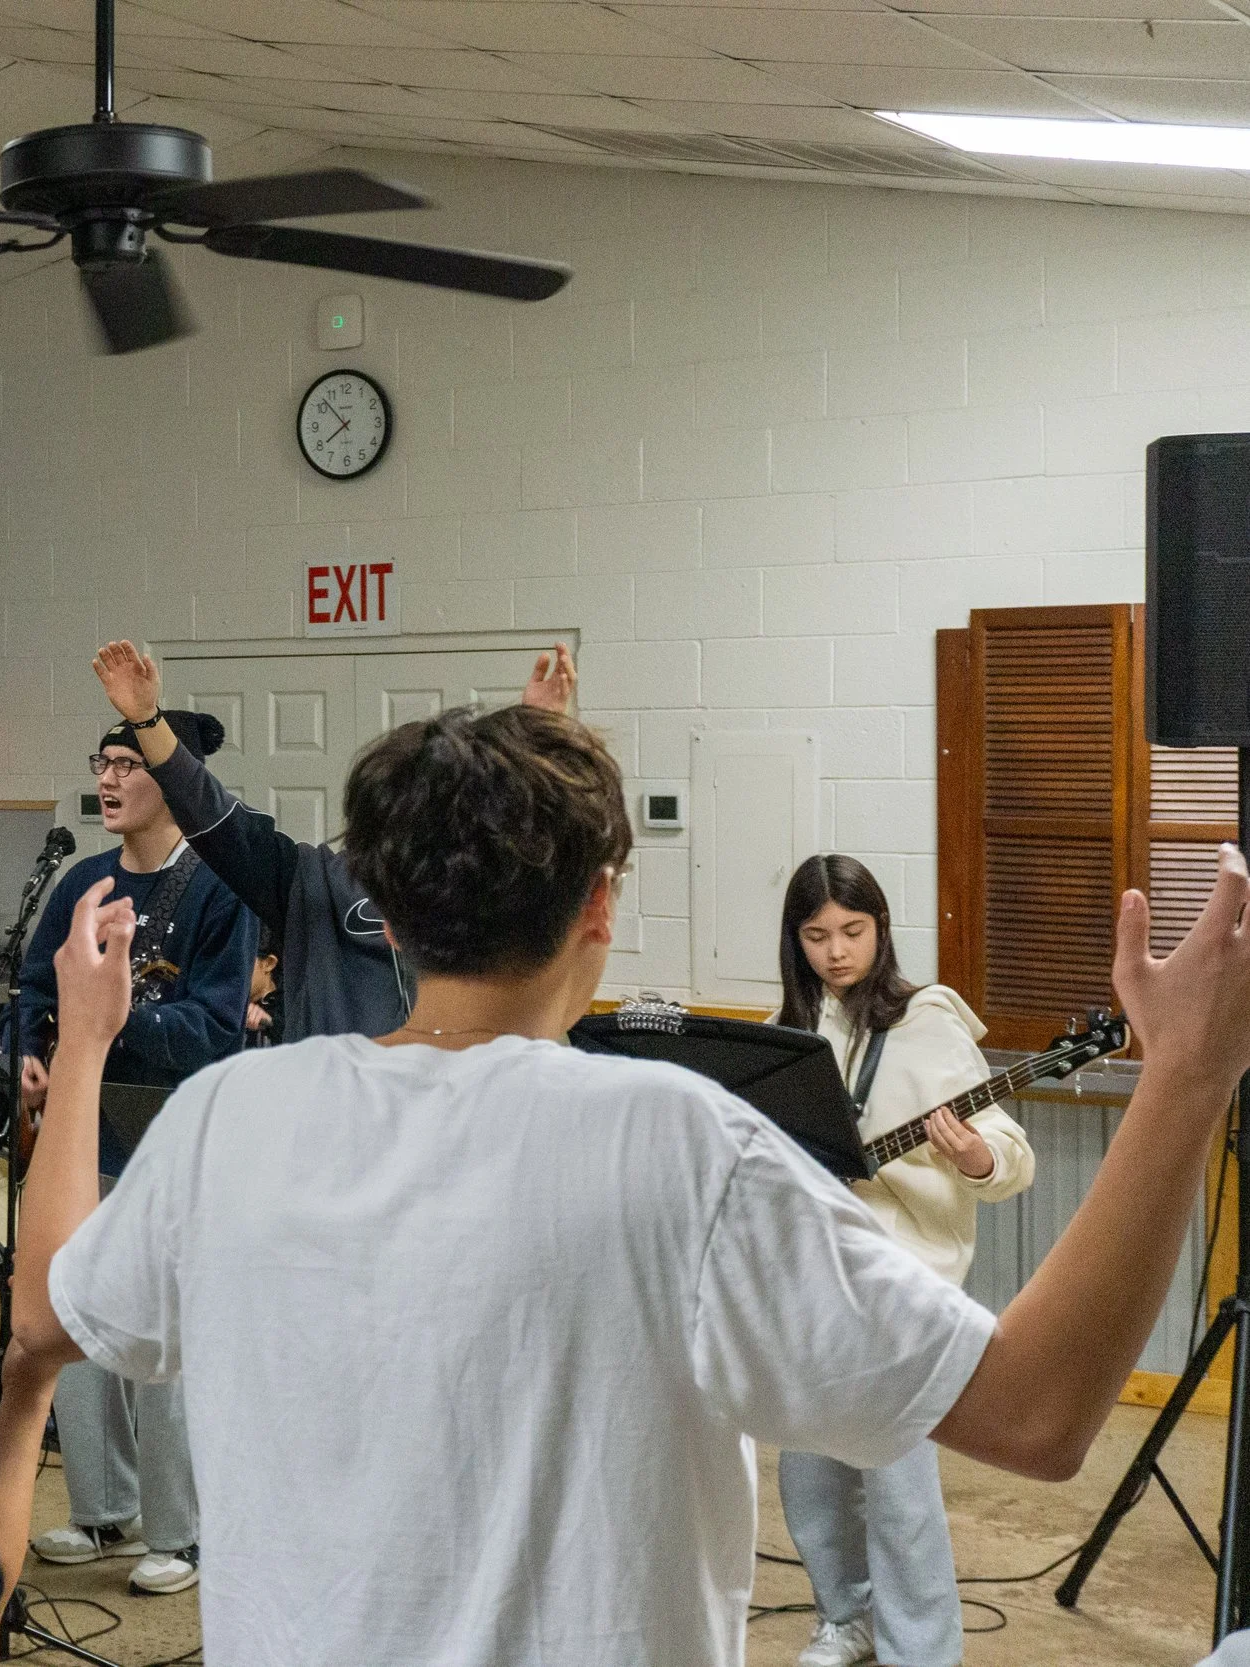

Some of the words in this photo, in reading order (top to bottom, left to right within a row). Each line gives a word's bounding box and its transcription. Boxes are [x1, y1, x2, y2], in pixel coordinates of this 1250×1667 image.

[340, 383, 352, 394] 12
[359, 387, 364, 398] 1
[328, 391, 336, 400] 11
[317, 402, 327, 414] 10
[370, 399, 377, 410] 2
[312, 422, 319, 433] 9
[375, 417, 382, 428] 3
[317, 440, 324, 451] 8
[370, 437, 377, 447] 4
[328, 451, 335, 462] 7
[359, 449, 366, 460] 5
[344, 455, 351, 467] 6
[308, 562, 393, 624] EXIT
